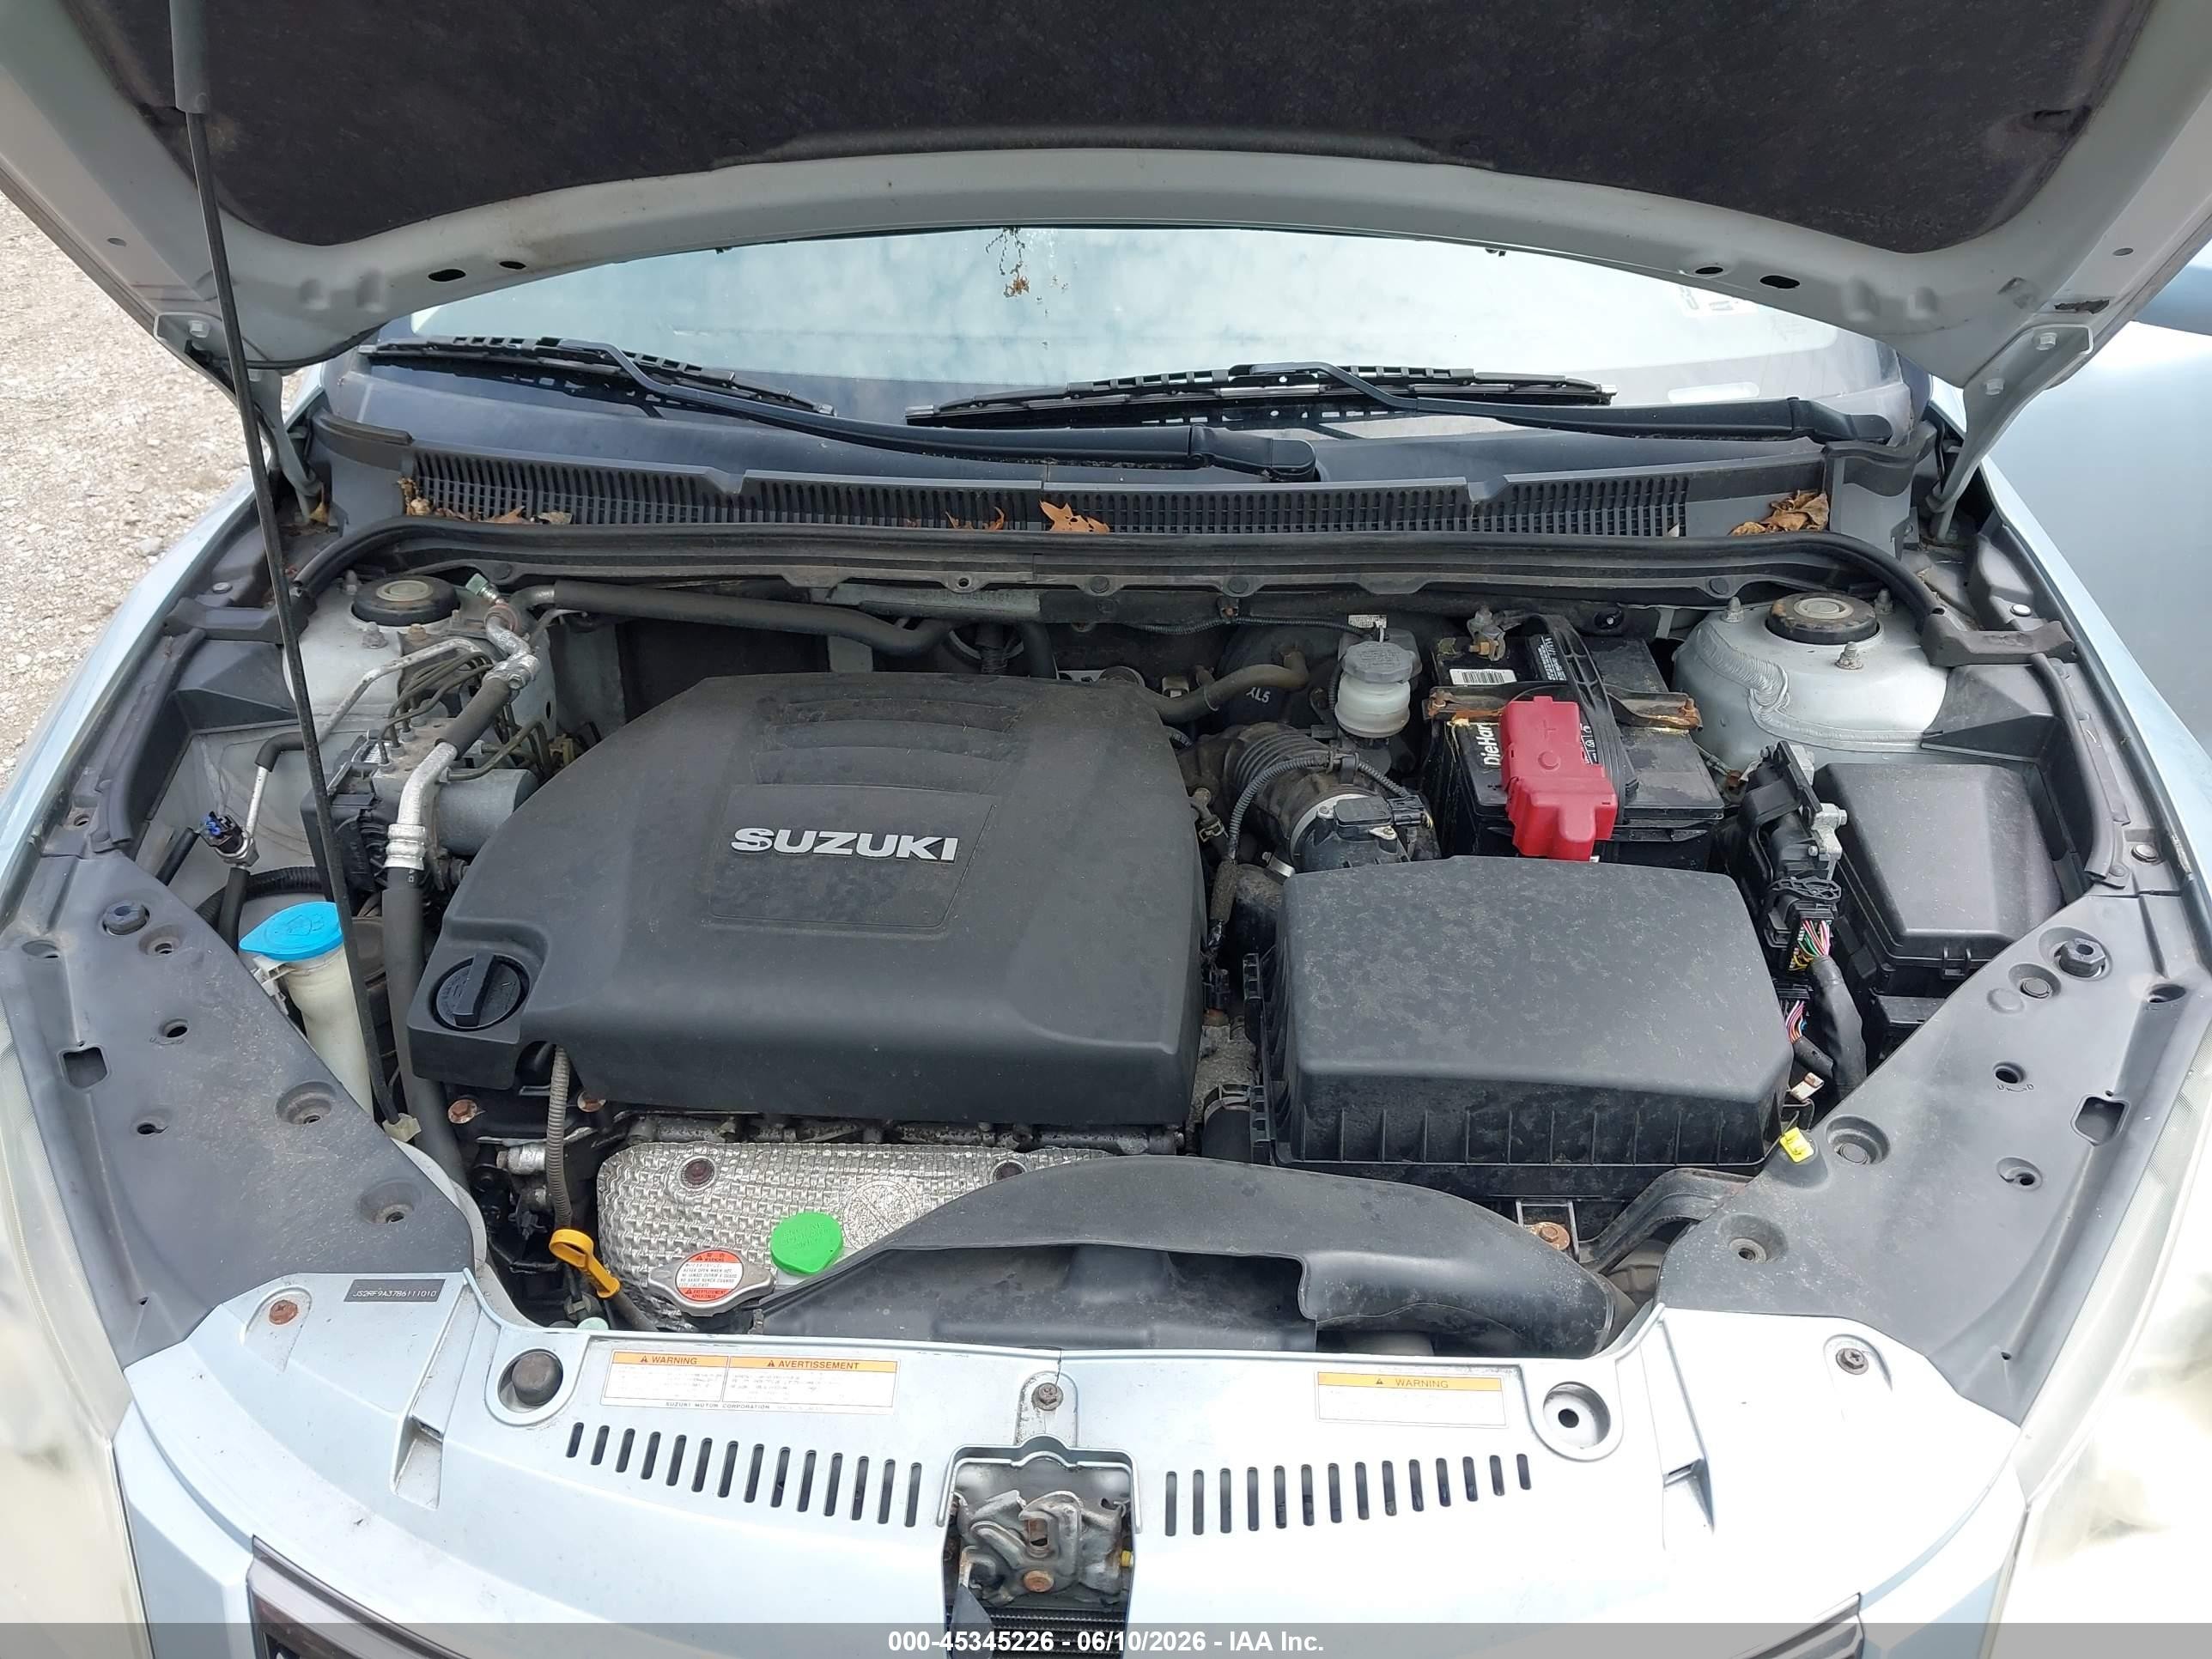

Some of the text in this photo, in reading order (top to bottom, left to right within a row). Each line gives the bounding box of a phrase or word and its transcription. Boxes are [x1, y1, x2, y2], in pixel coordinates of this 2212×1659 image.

[1475, 722, 1501, 767] DieHar
[731, 828, 958, 862] SUZUKI
[652, 1356, 697, 1365] WARNING
[778, 1360, 860, 1370] AVERTISSEMENT
[1395, 1377, 1449, 1389] WARNING
